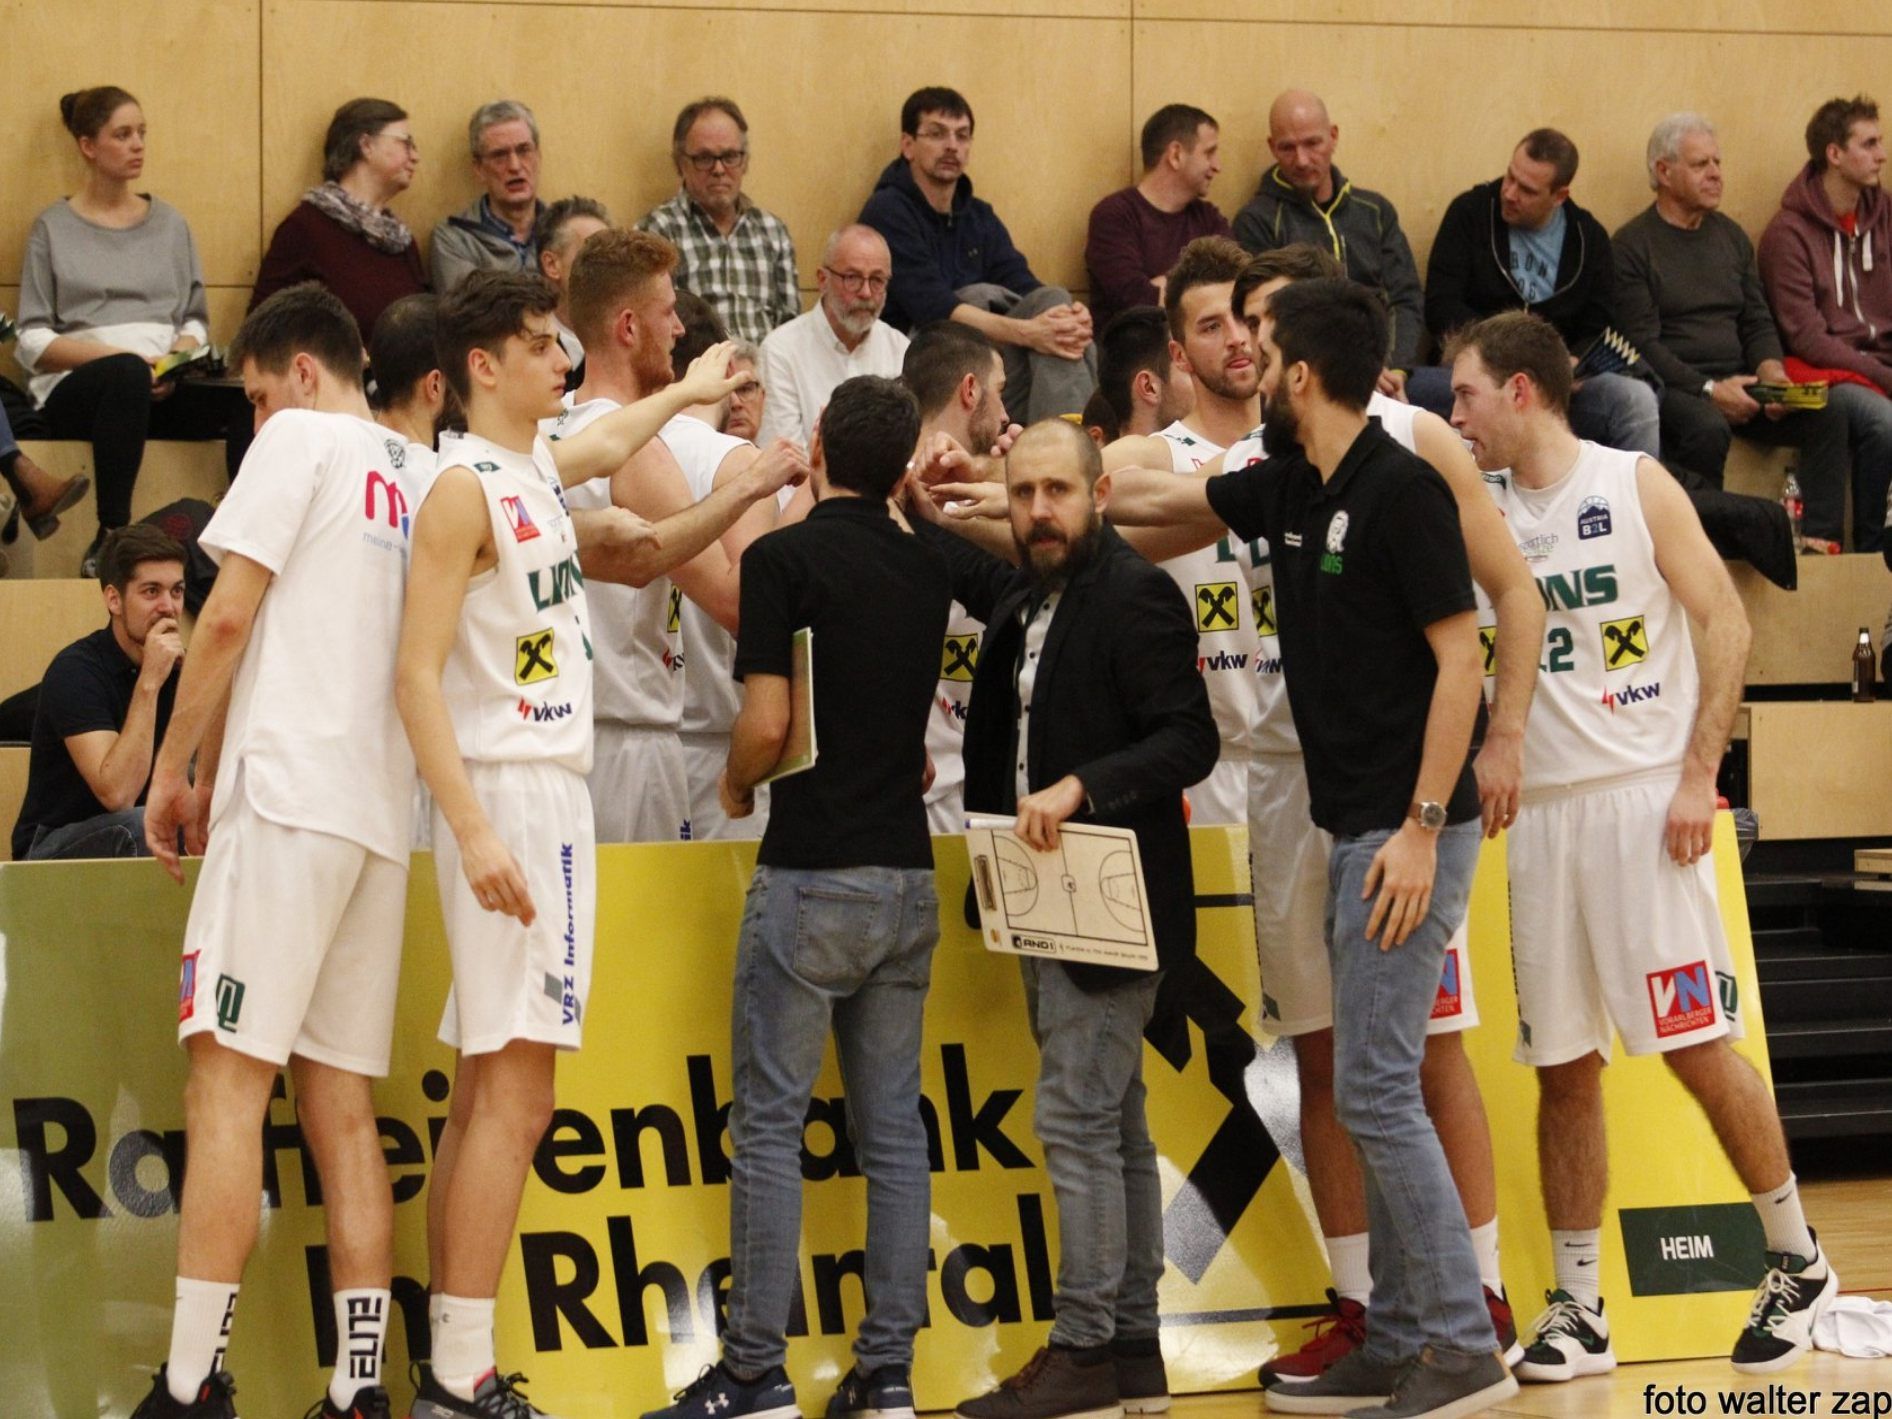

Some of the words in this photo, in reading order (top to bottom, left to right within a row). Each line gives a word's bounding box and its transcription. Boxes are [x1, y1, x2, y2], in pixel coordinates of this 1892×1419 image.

[1207, 651, 1248, 671] vkw
[1616, 682, 1661, 706] vkw
[533, 702, 572, 723] vkw
[560, 842, 575, 967] Informatik
[561, 976, 575, 1025] VRZ
[1651, 965, 1711, 1018] VN
[1660, 1235, 1714, 1261] HEIM
